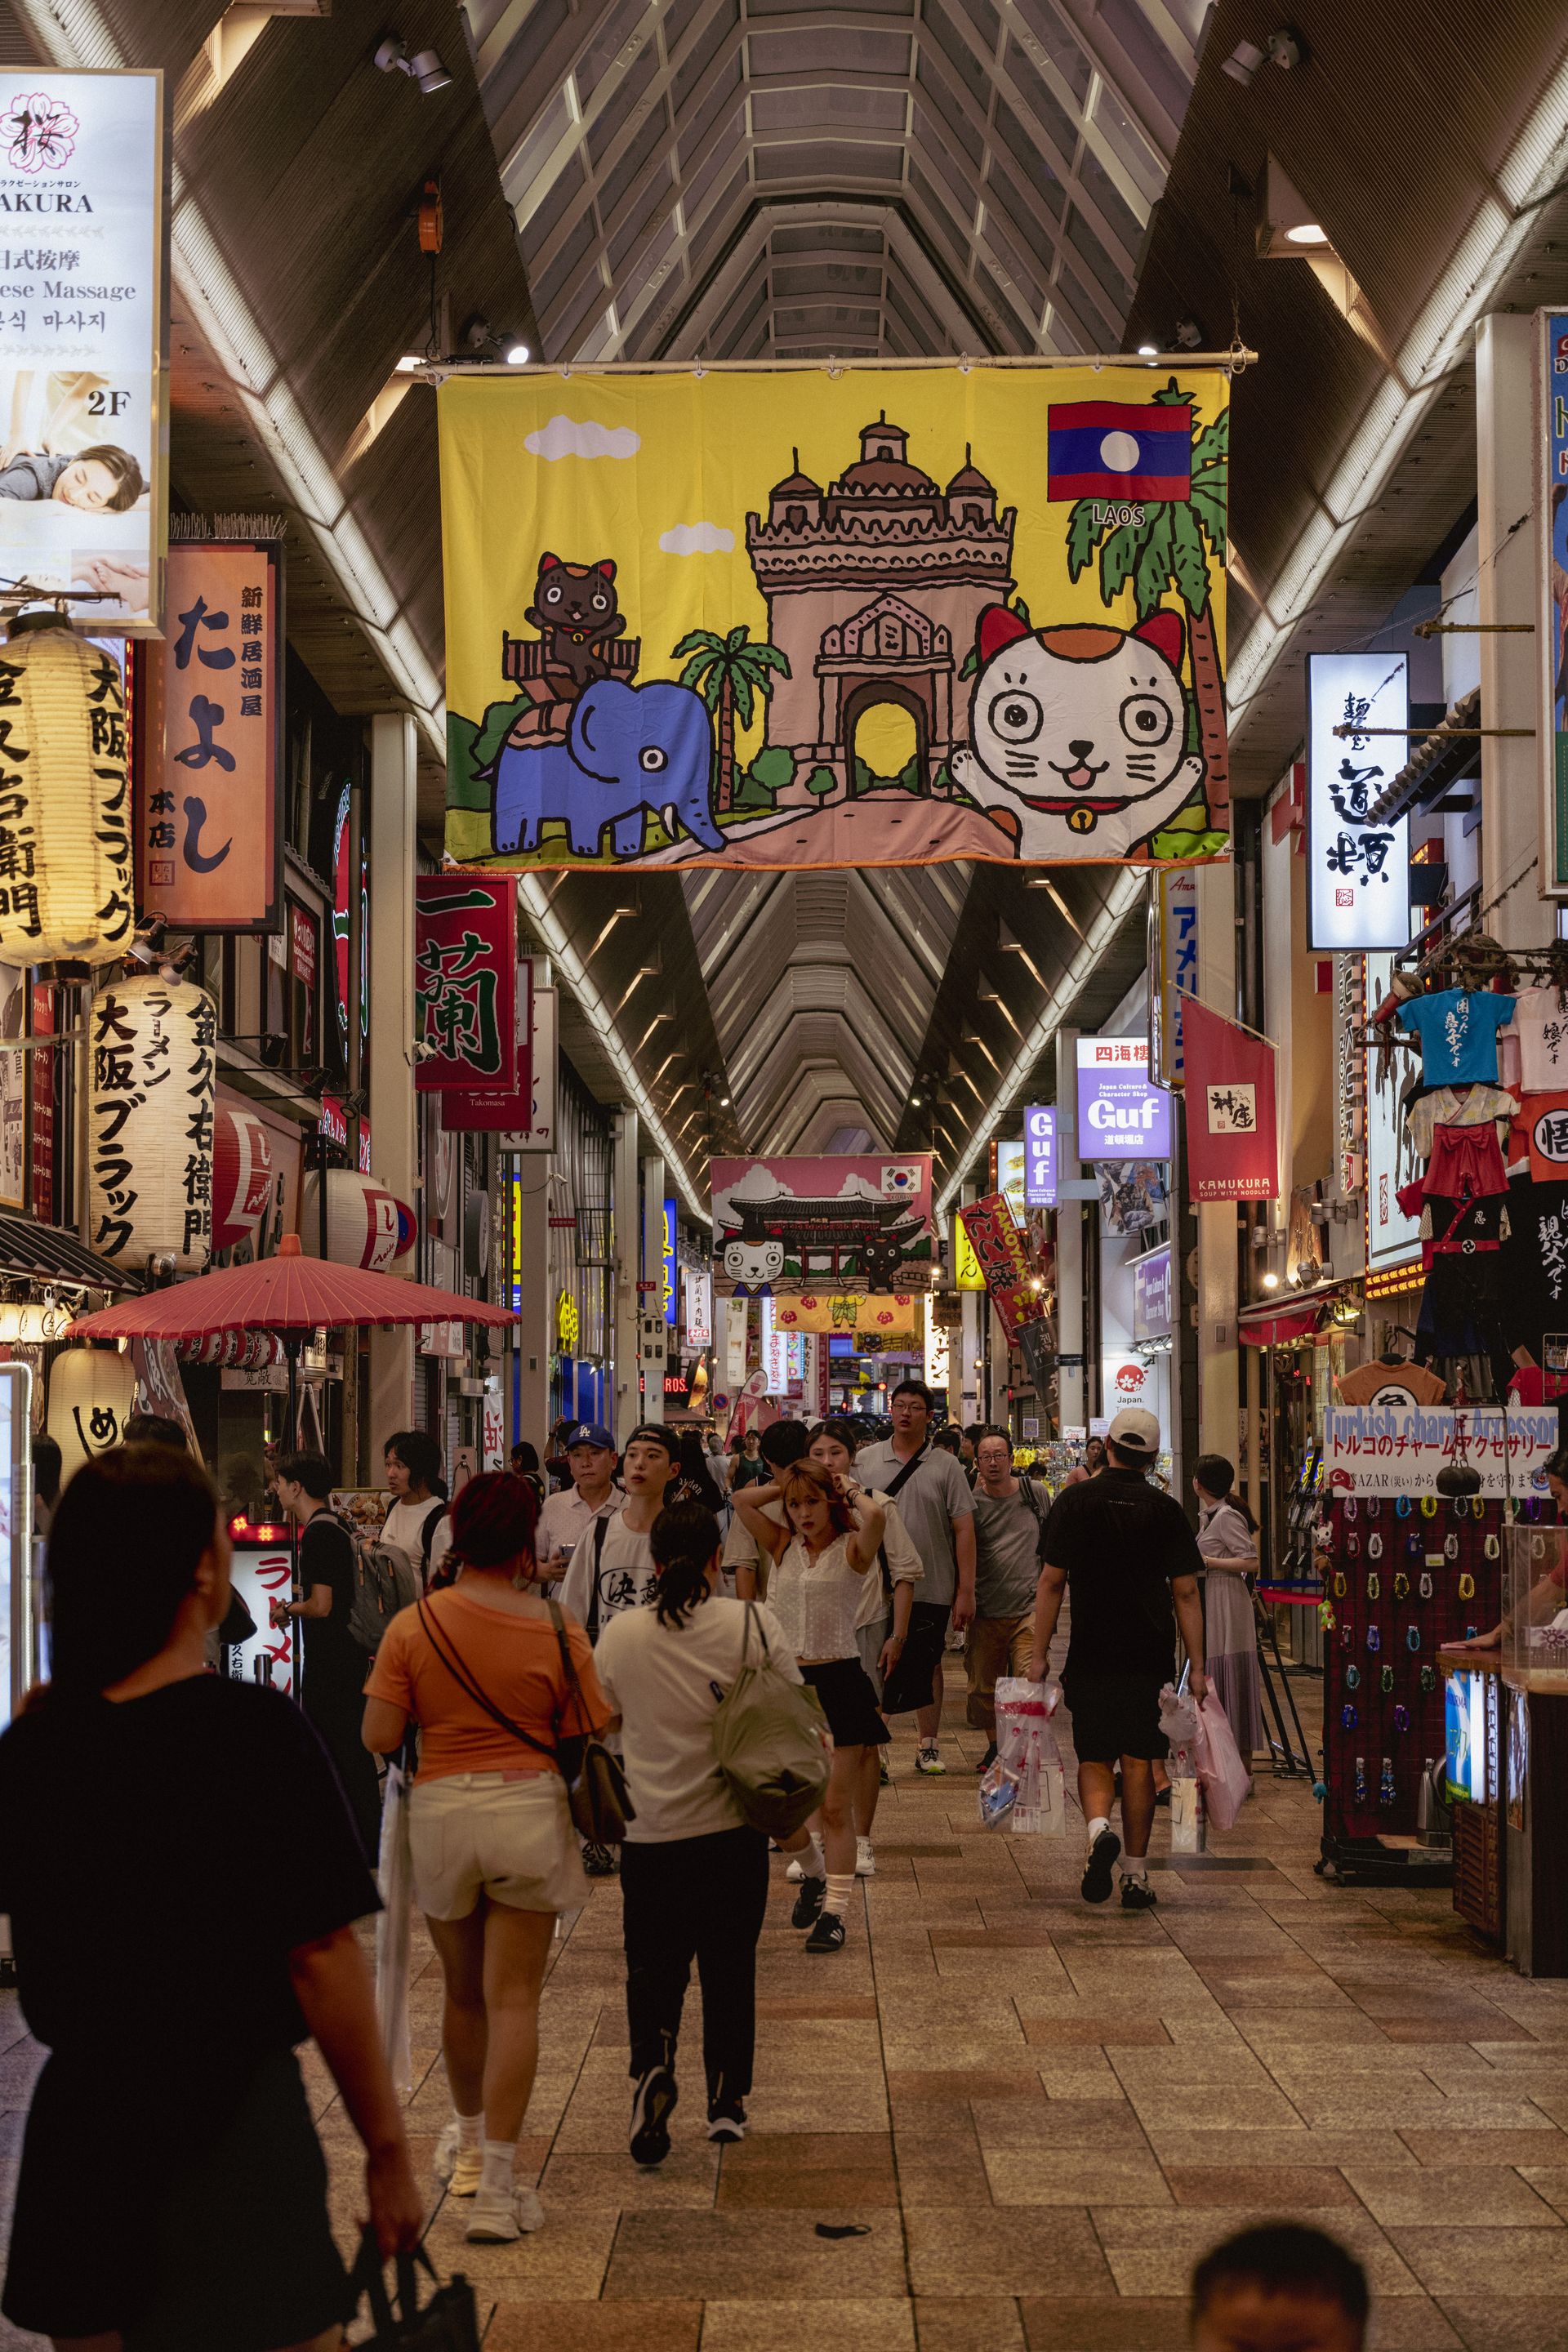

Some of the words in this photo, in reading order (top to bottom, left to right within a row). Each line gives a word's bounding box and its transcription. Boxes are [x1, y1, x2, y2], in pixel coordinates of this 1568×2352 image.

[11, 110, 64, 155] 桜
[43, 281, 136, 301] Massage
[0, 310, 26, 332] 식
[43, 310, 106, 333] 마사지
[87, 390, 131, 416] 2F
[1093, 504, 1146, 527] LAOS
[240, 586, 263, 717] 新鮮居酒屋
[173, 595, 237, 874] たよし
[149, 787, 176, 849] 本店
[1456, 997, 1469, 1034] 困った
[142, 991, 172, 1088] ラーメン
[1445, 1011, 1462, 1068] 息子です
[470, 1098, 506, 1107] Takomasa
[1087, 1098, 1160, 1129] Guf
[93, 993, 147, 1258] 大阪ブラック
[1030, 1112, 1053, 1186] Guf
[1199, 1178, 1271, 1190] KAMUKURA
[1117, 1396, 1144, 1405] Japan.
[1325, 1405, 1397, 1445] Turkish
[1333, 1433, 1552, 1459] トルコのチャームアクセサリー
